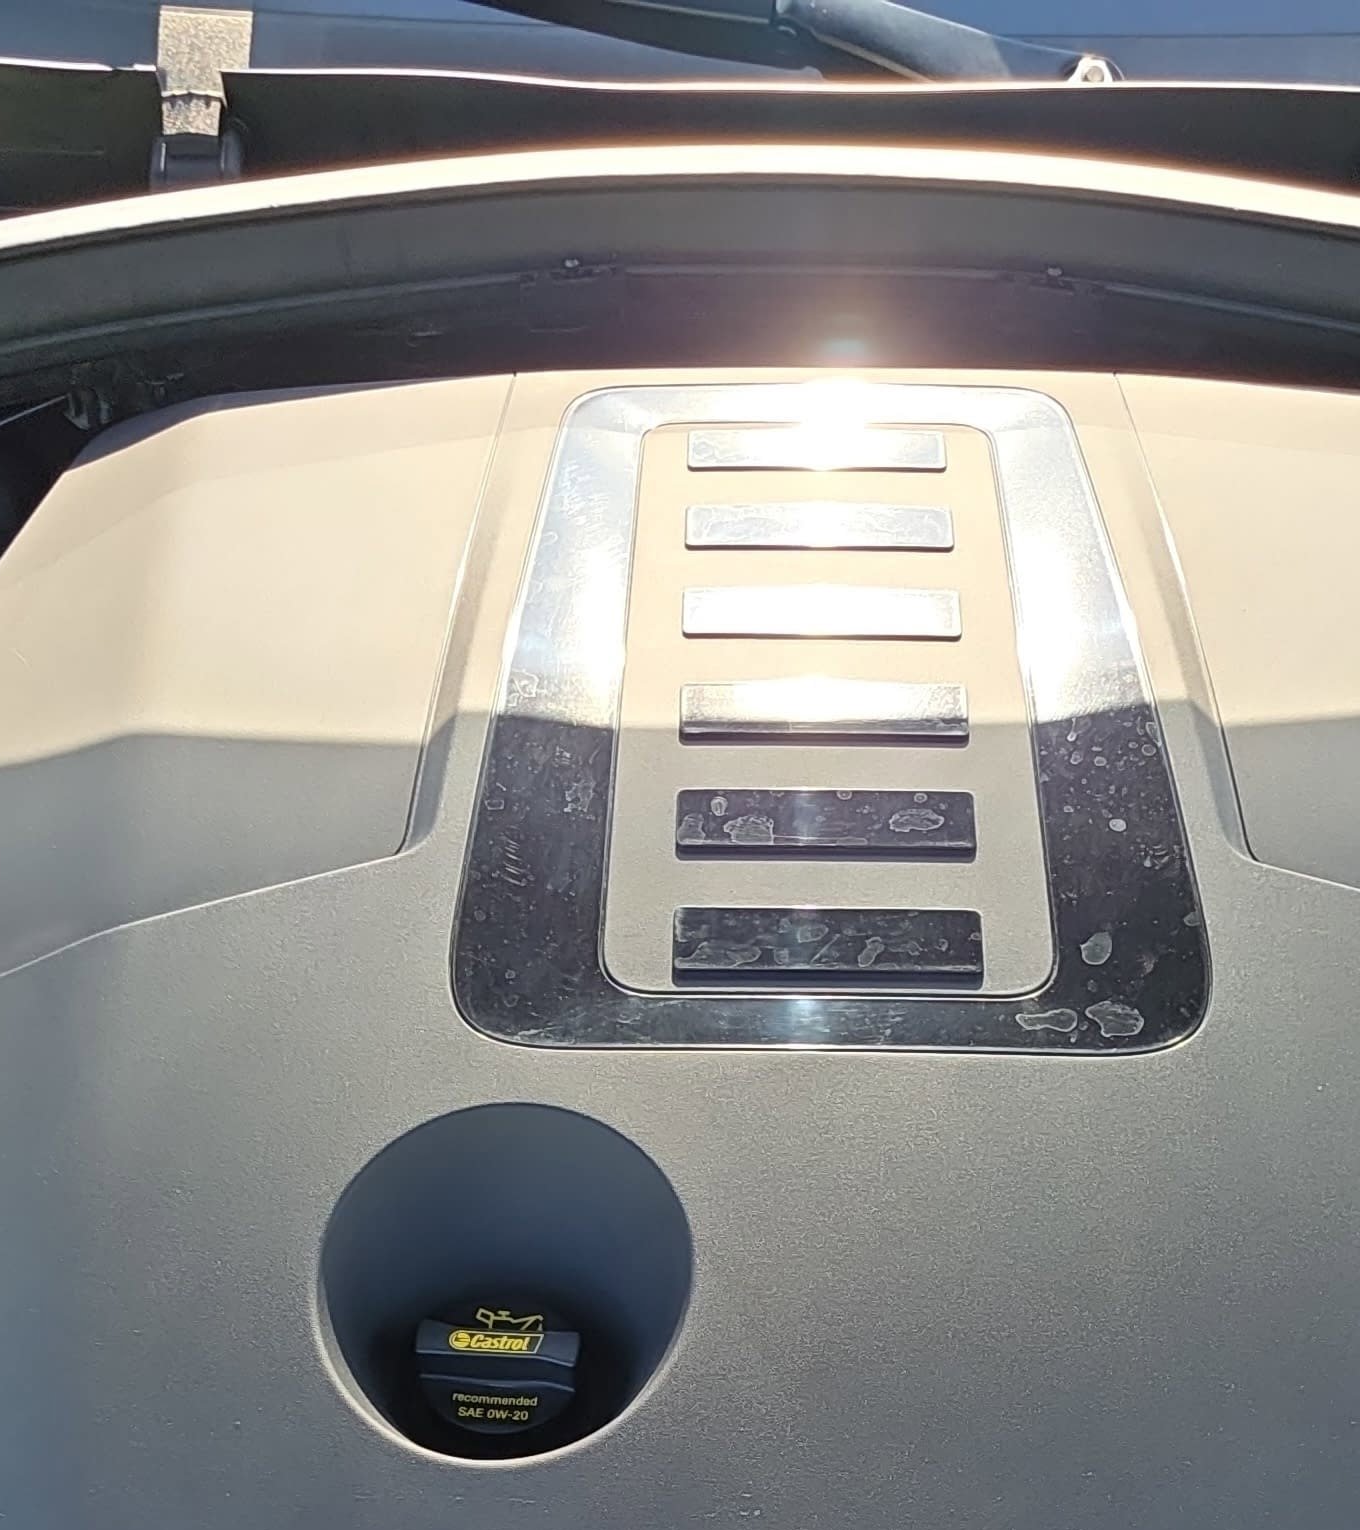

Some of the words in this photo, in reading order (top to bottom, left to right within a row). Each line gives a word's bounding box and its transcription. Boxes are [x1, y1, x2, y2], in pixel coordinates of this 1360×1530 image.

[471, 1334, 528, 1350] Castrol
[452, 1393, 538, 1406] recommended
[458, 1407, 484, 1418] SAE
[486, 1408, 529, 1421] 0W-20
